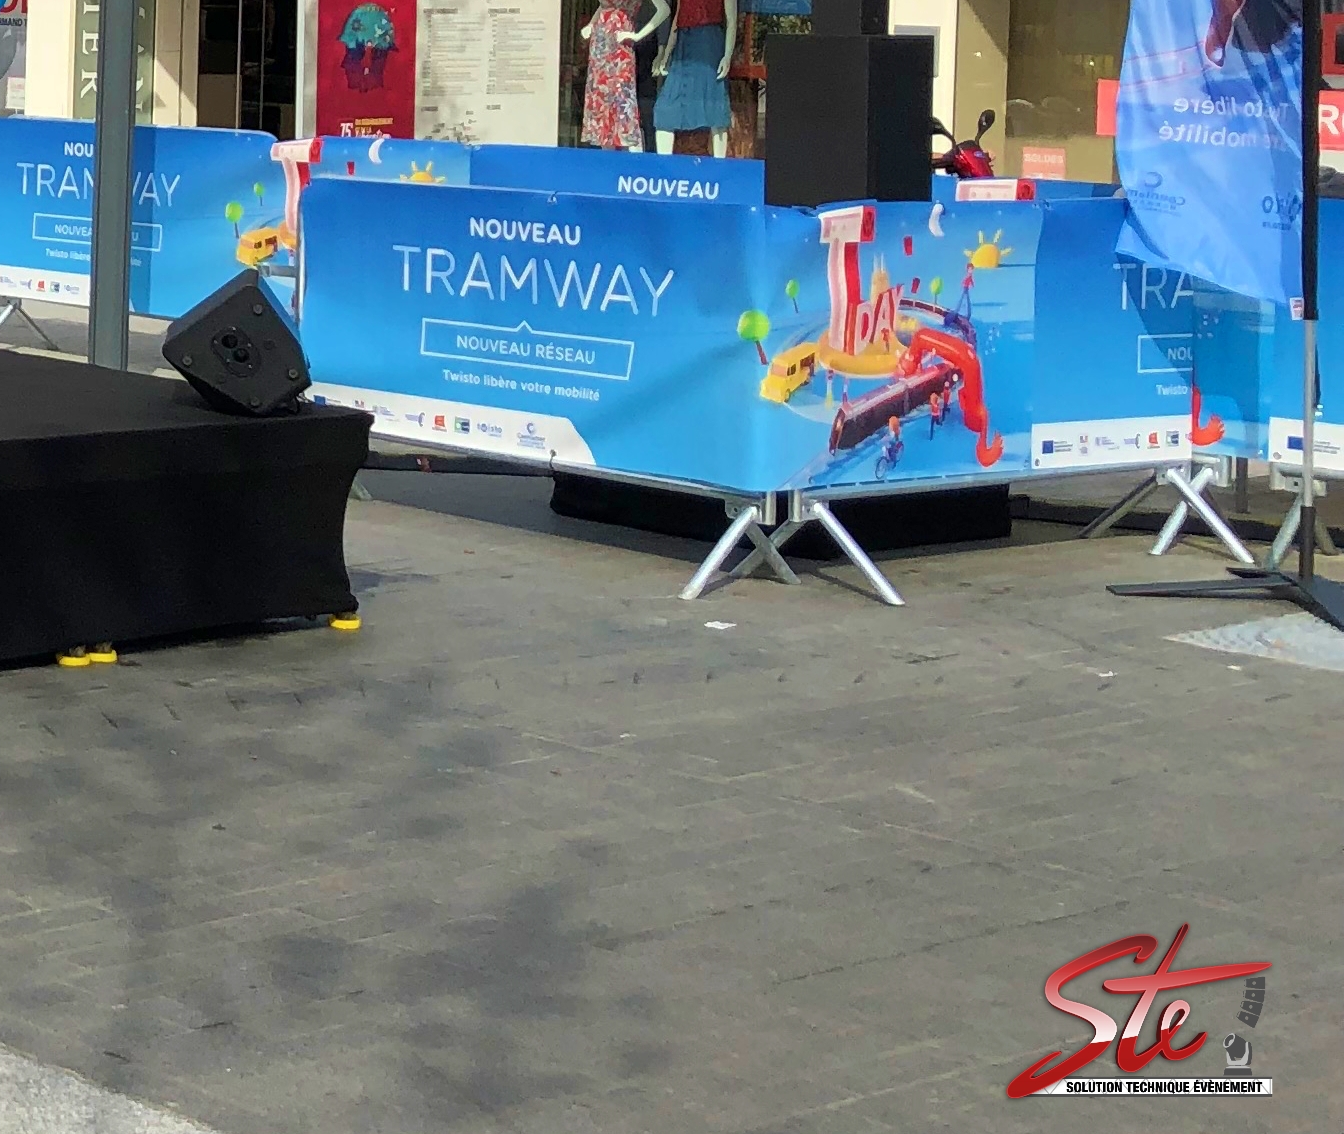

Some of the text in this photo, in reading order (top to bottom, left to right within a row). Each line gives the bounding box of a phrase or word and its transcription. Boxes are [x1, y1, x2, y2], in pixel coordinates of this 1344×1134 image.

[1318, 104, 1344, 136] R
[618, 175, 720, 200] NOUVEAU
[469, 216, 582, 247] NOUVEAU
[392, 244, 675, 317] TRAMWAY
[817, 205, 905, 356] T DAY
[456, 334, 596, 366] NOUVEAU RÉSEAU
[442, 369, 601, 402] Twisto libère votre mobilité
[1155, 383, 1188, 396] Twisto
